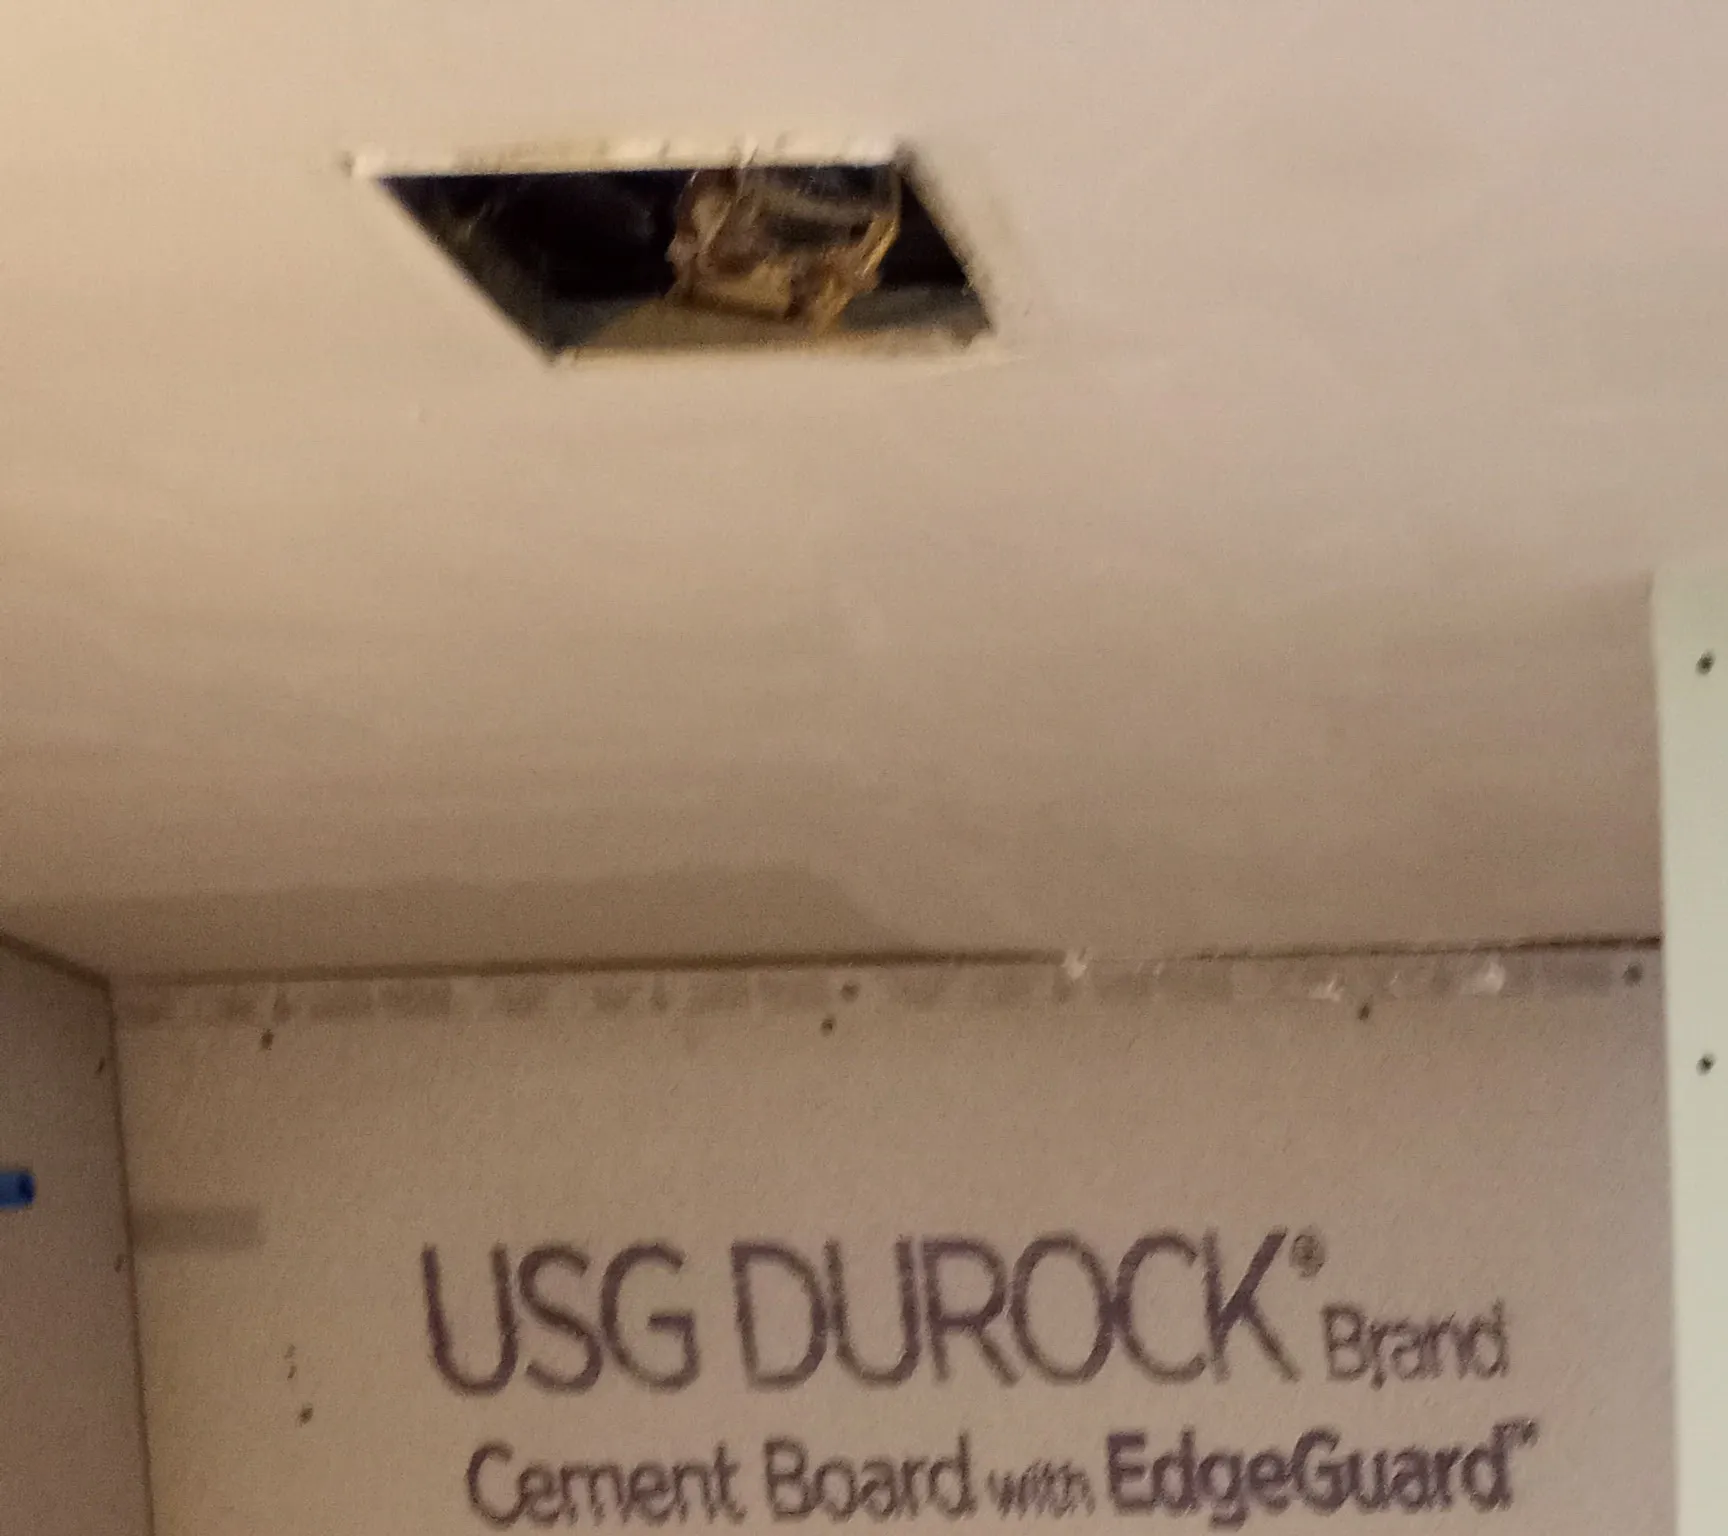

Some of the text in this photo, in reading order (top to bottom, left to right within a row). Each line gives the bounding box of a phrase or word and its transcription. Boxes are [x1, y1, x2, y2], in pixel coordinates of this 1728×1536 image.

[420, 1241, 699, 1396] USG
[1322, 1300, 1509, 1389] Brand
[464, 1440, 746, 1530] Cement
[763, 1433, 977, 1521] Board
[986, 1460, 1095, 1518] with
